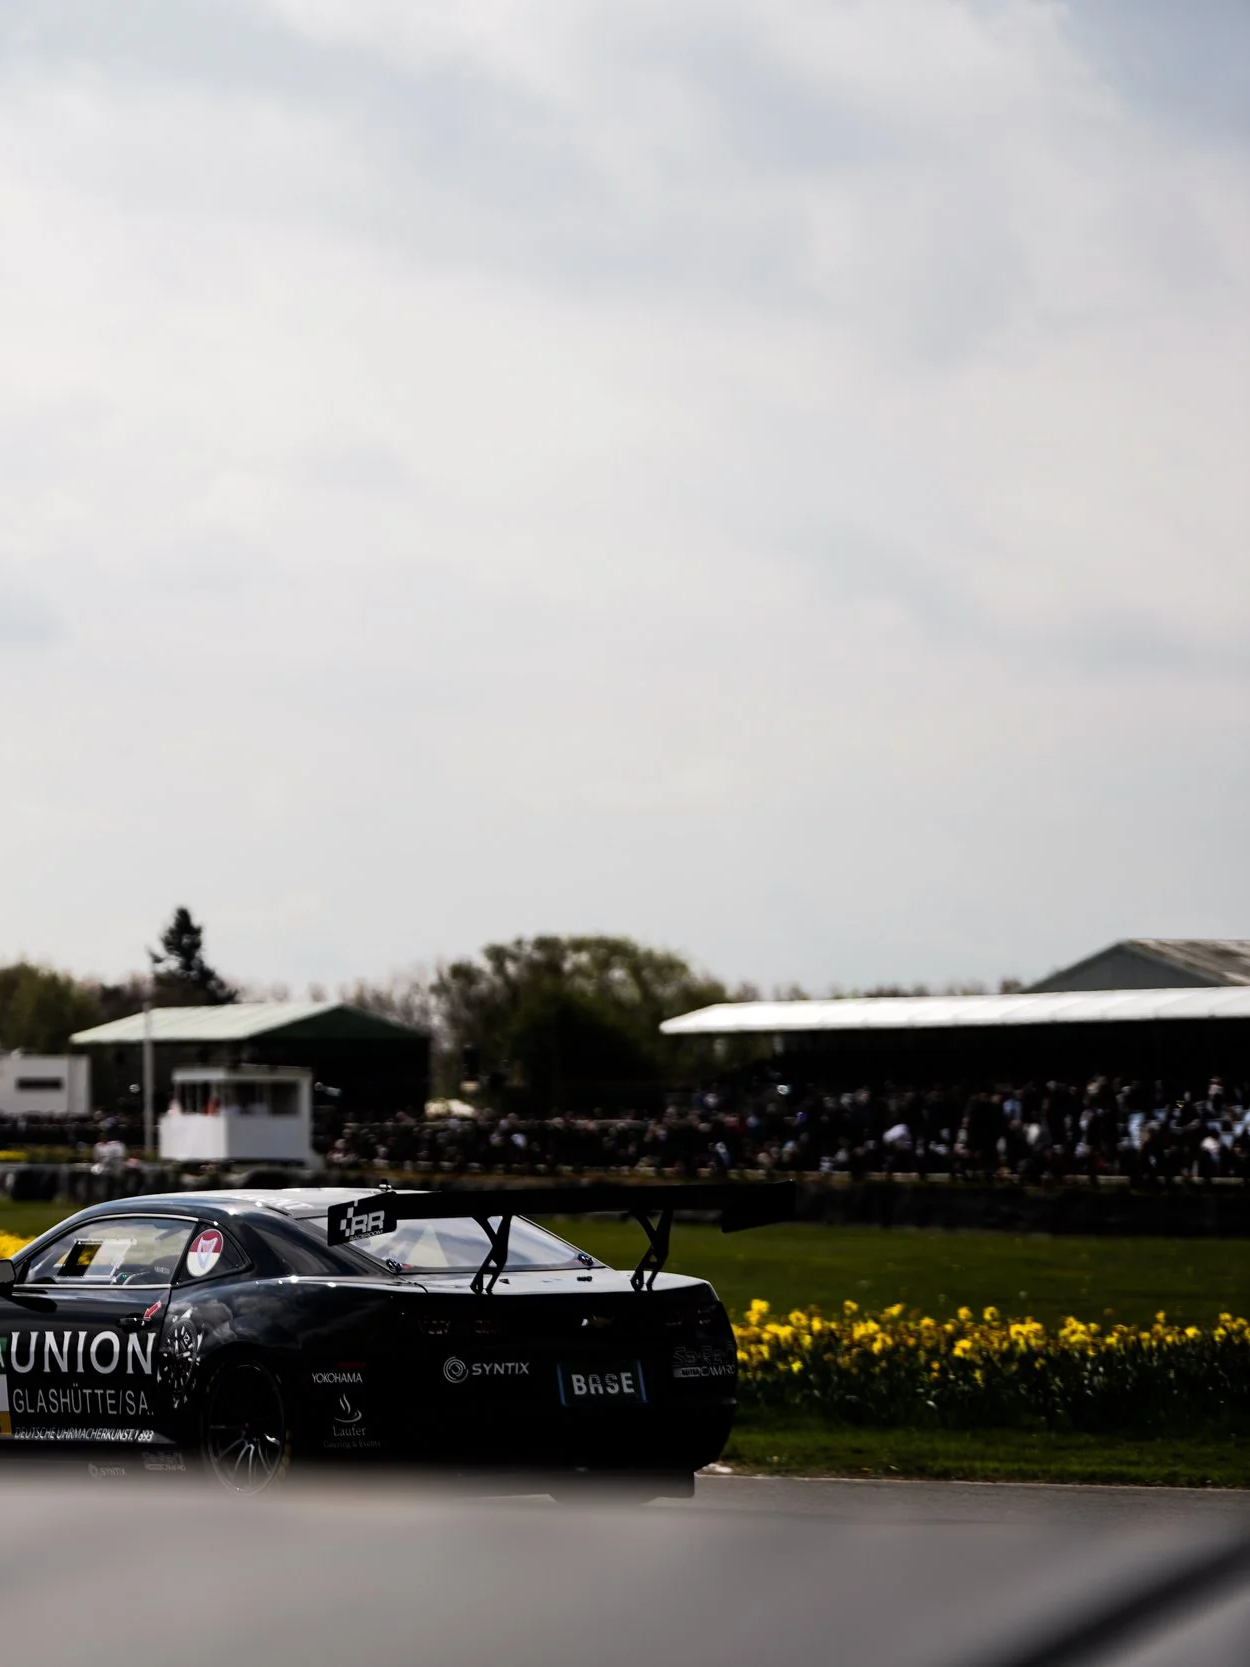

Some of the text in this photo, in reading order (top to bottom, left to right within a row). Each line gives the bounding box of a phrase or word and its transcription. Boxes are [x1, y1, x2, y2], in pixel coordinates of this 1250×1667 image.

[9, 1330, 157, 1375] UNION
[471, 1361, 530, 1376] SYNTIX
[311, 1371, 363, 1384] YOKOHAMA
[570, 1371, 635, 1396] BASE
[14, 1426, 56, 1441] DEUTSCHE
[332, 1424, 367, 1437] Laufer
